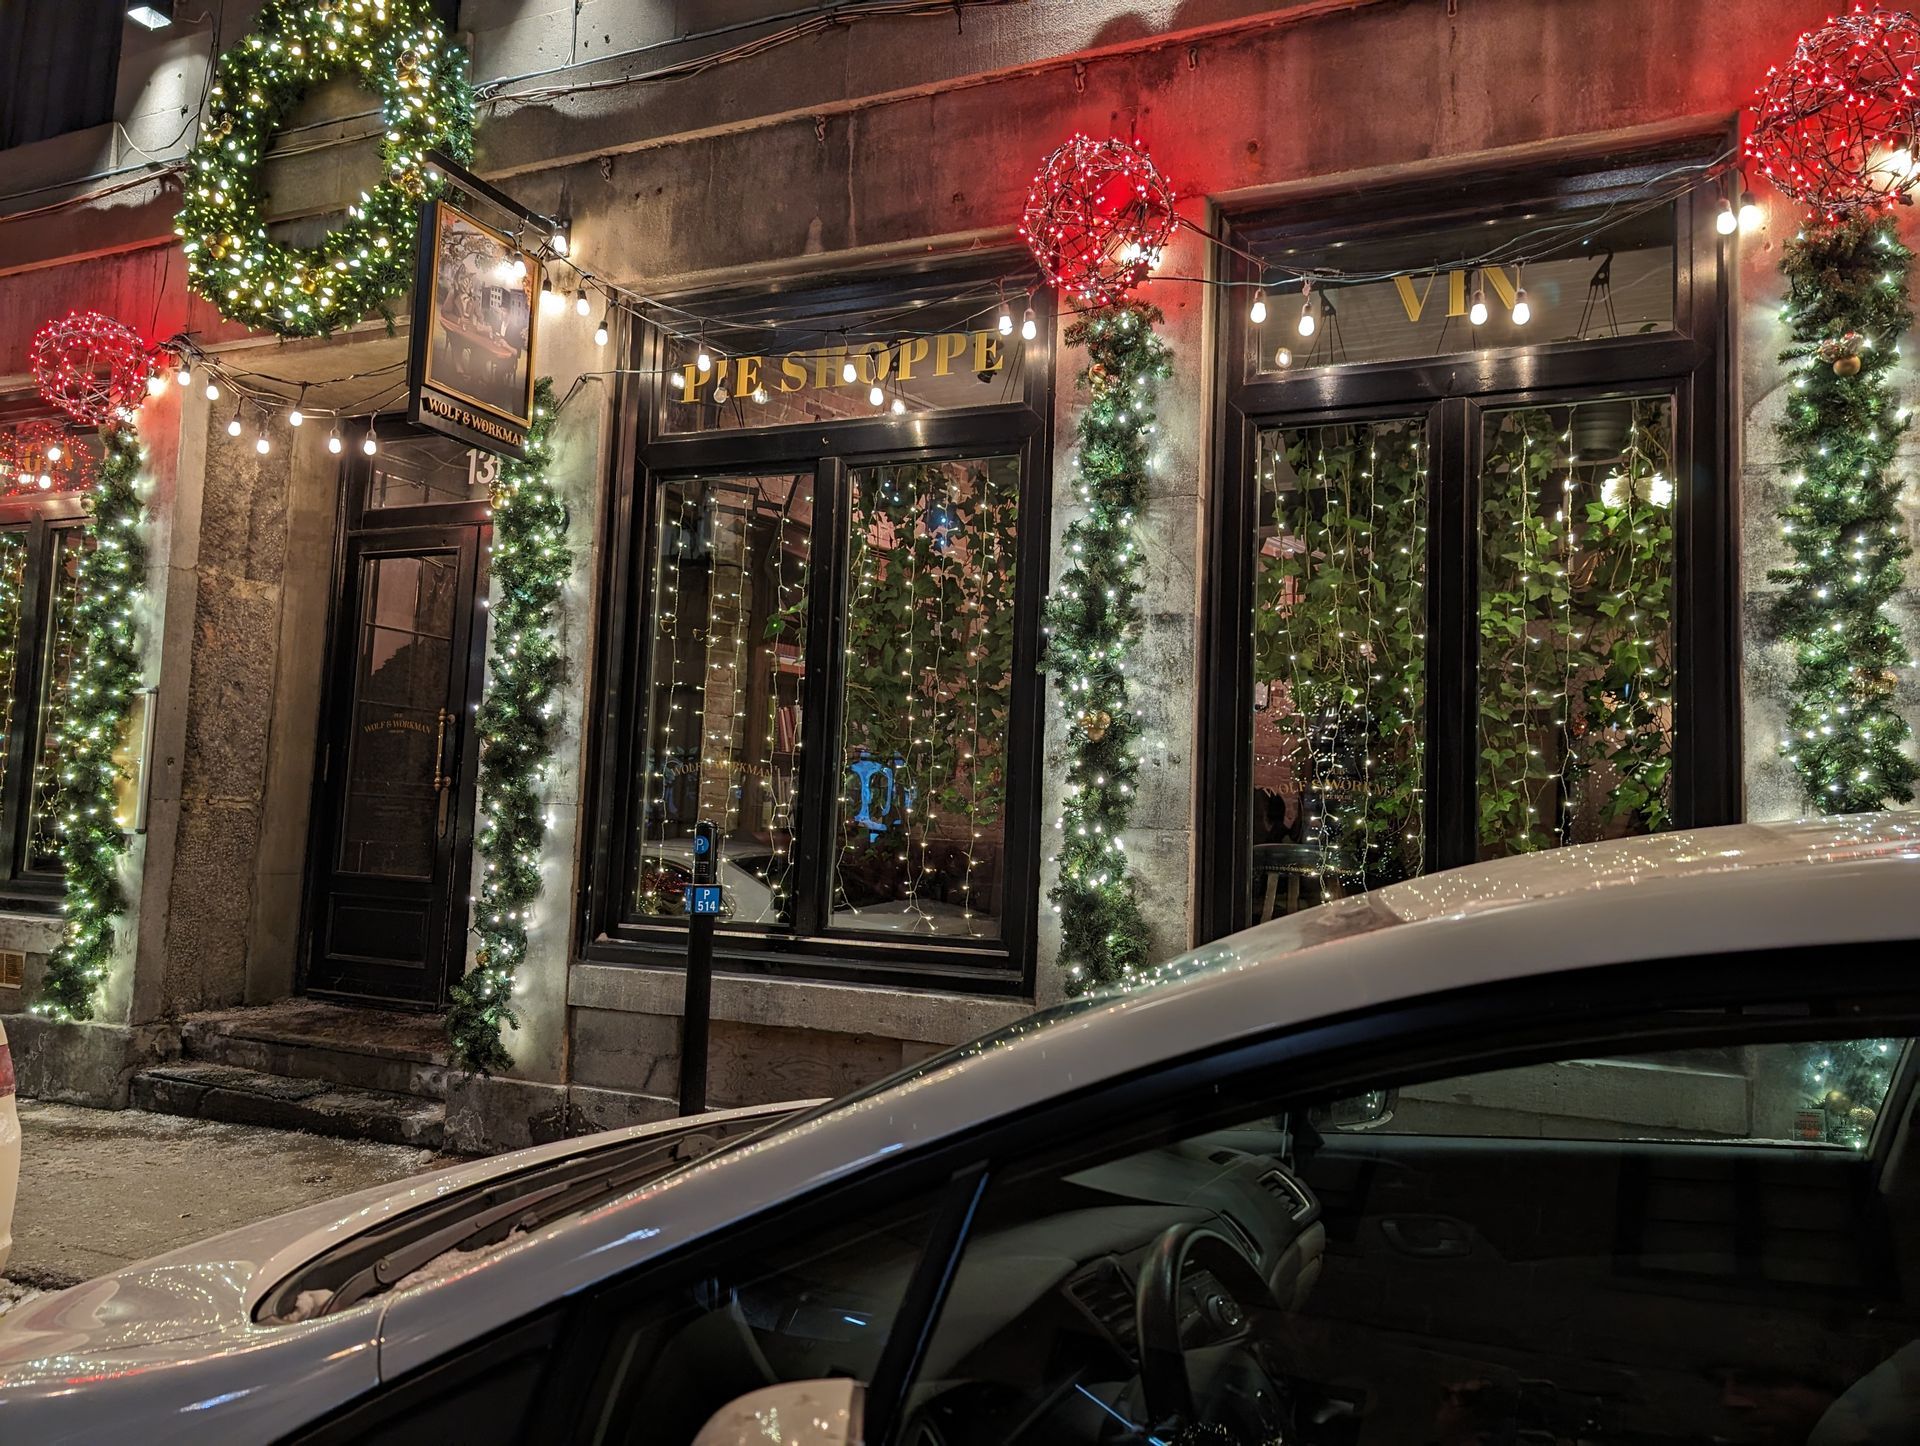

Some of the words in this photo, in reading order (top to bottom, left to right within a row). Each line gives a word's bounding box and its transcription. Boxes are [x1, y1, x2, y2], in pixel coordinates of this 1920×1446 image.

[1391, 264, 1524, 321] VIN
[781, 330, 1003, 392] SHOPPE
[428, 397, 461, 420] WOLF
[462, 411, 471, 425] &
[1263, 780, 1307, 798] WOLF
[697, 901, 716, 911] 514
[703, 889, 711, 900] P
